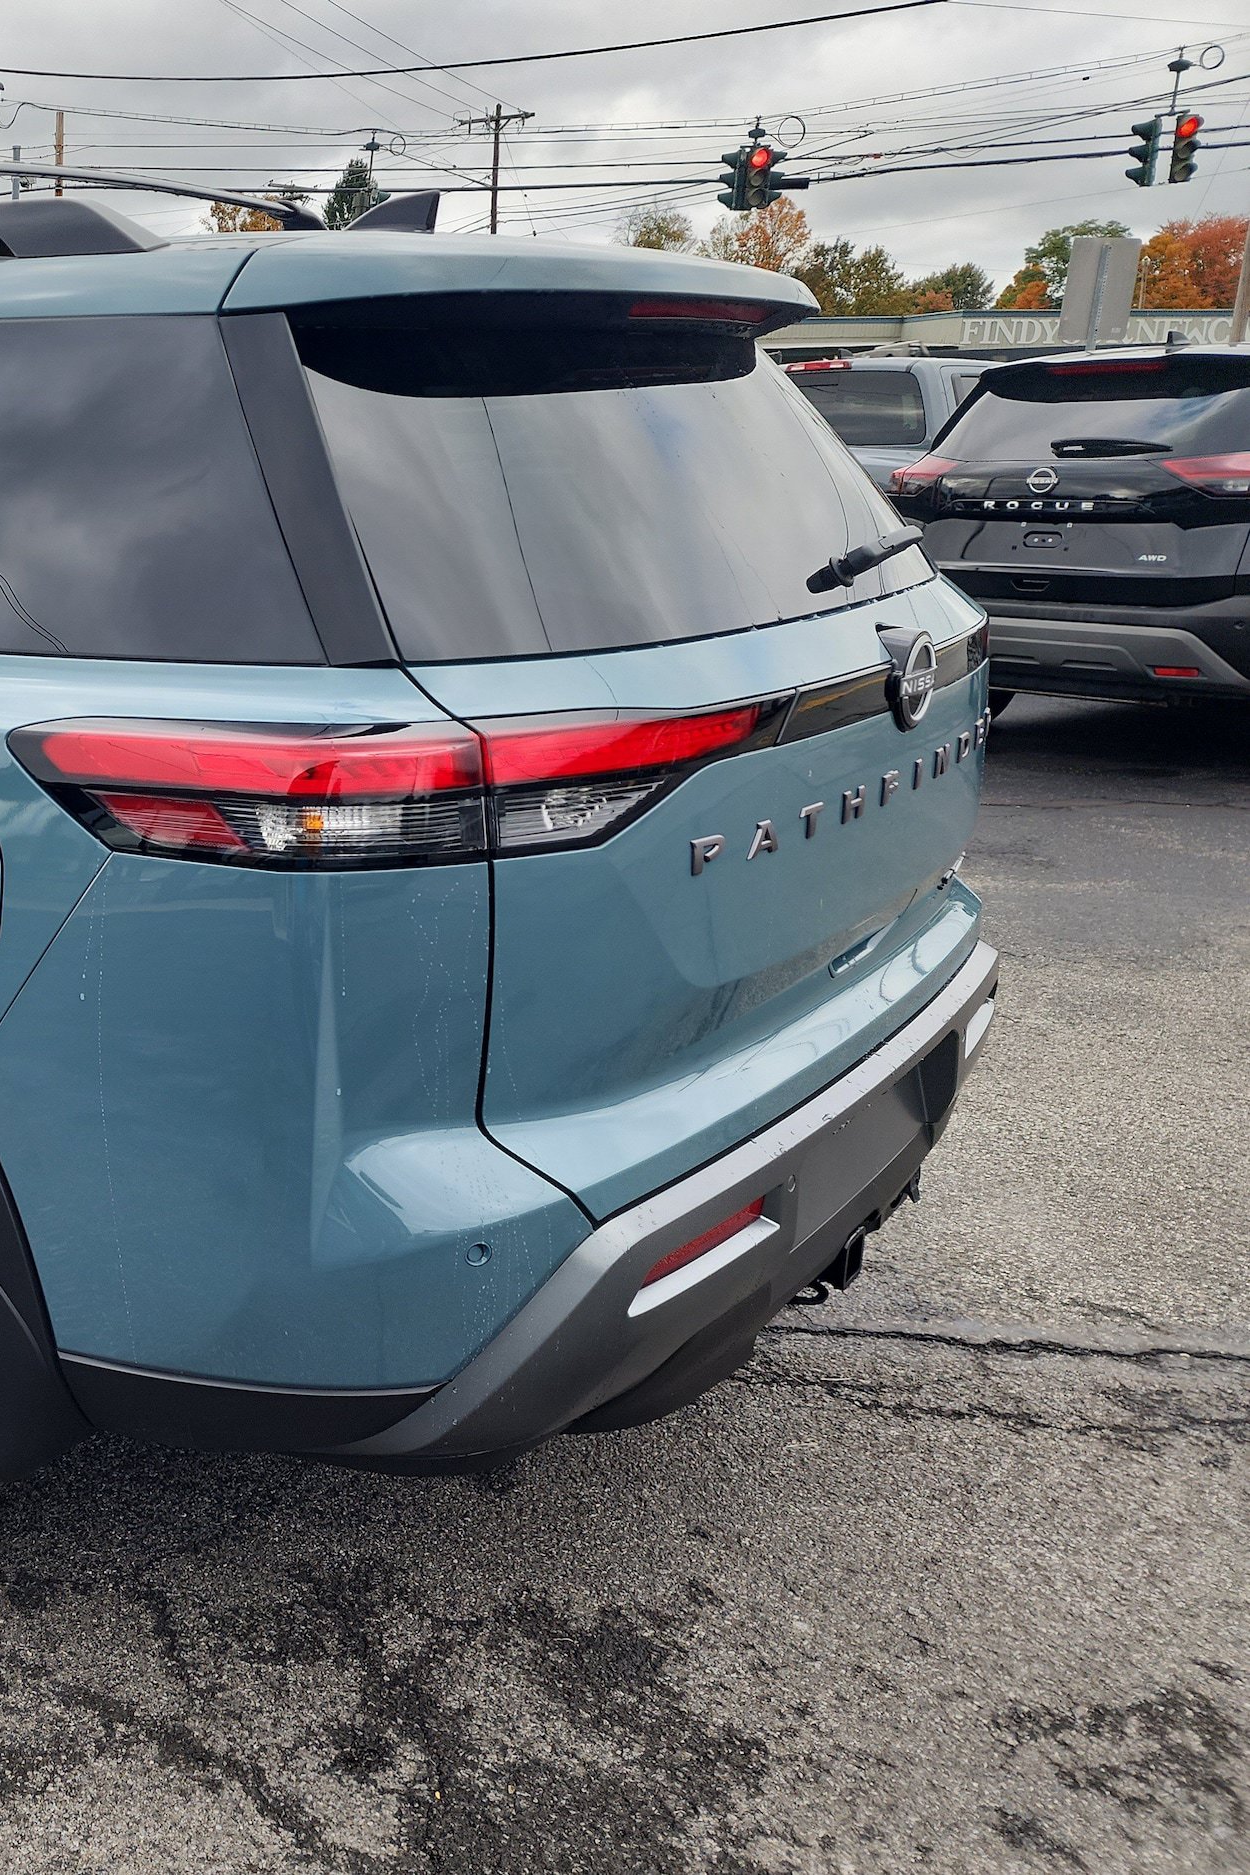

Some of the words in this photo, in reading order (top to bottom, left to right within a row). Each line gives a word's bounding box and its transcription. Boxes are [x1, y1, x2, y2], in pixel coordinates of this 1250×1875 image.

[960, 319, 1042, 344] FIND
[983, 500, 1095, 511] ROGUE
[1138, 553, 1167, 563] AWD
